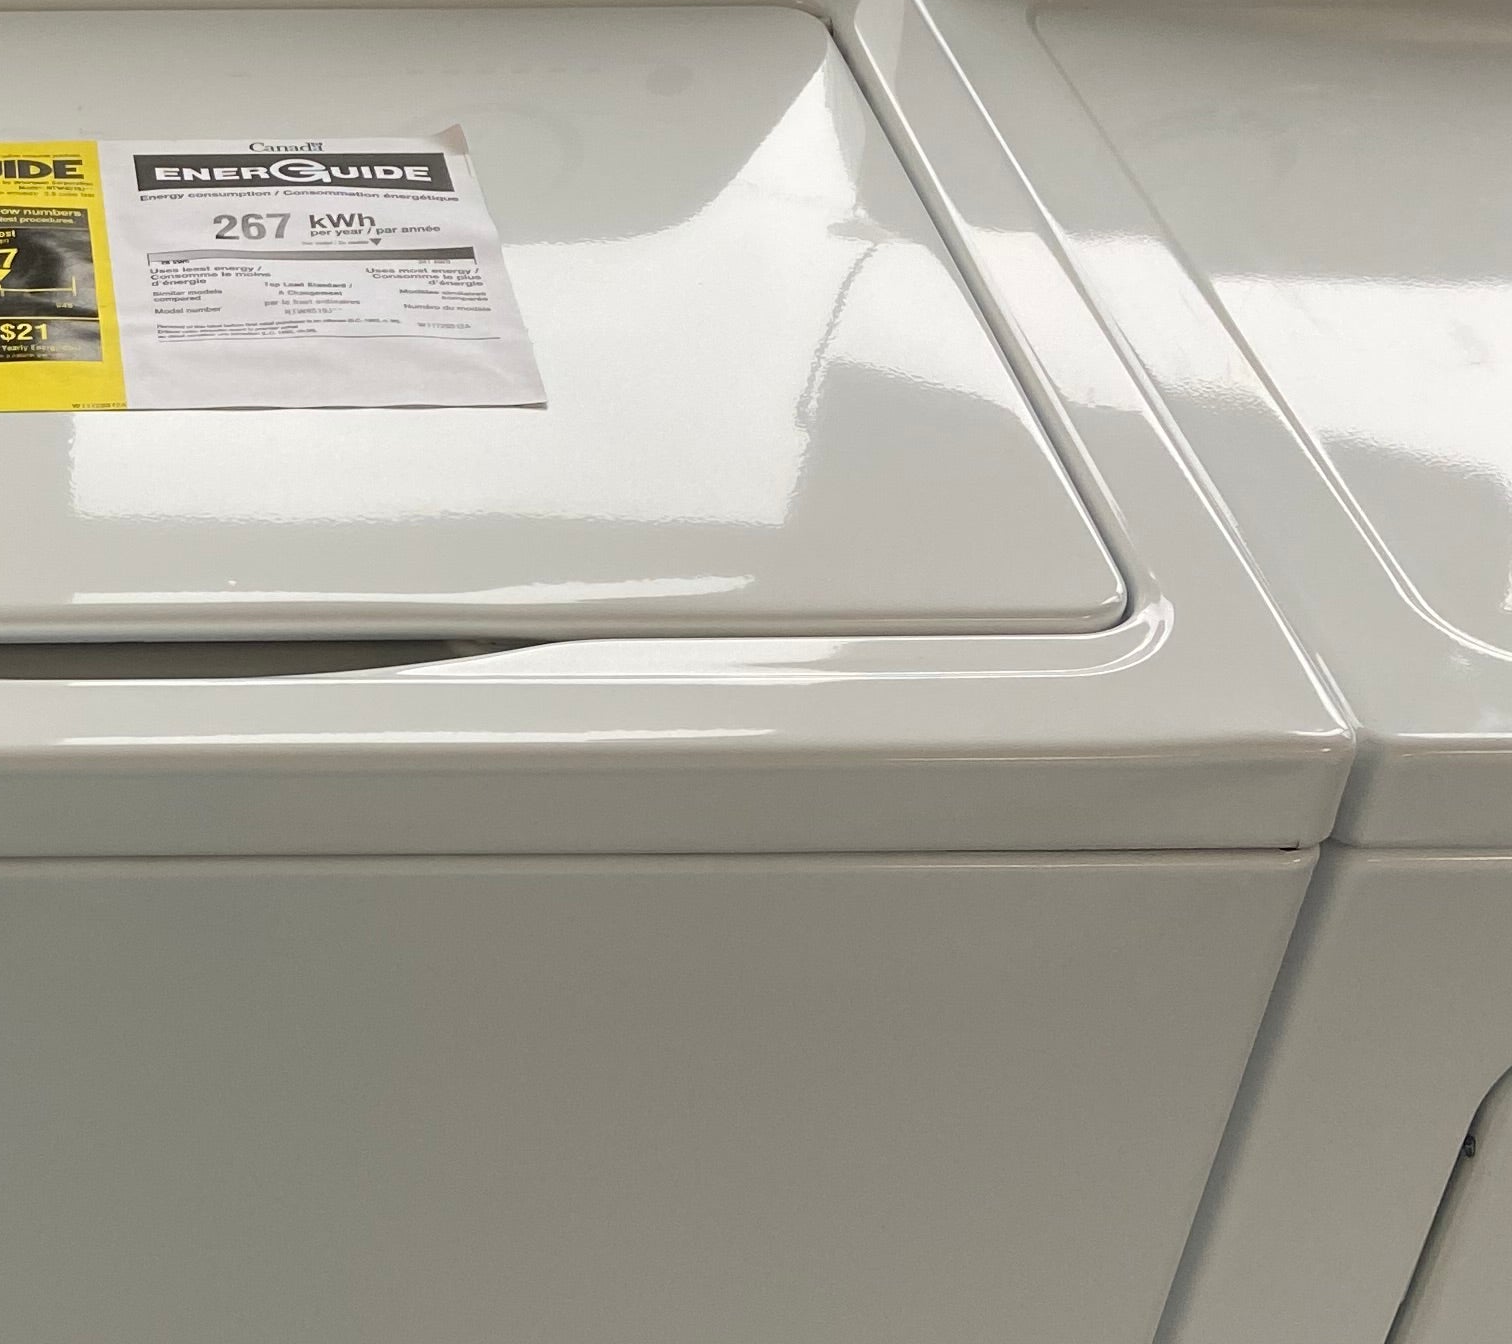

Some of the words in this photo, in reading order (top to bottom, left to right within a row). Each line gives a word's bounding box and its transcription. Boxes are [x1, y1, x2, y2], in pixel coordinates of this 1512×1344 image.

[155, 158, 432, 183] ENERGUIDE
[140, 192, 184, 201] Energy
[188, 190, 271, 198] consumption
[283, 190, 380, 198] Consommation
[23, 209, 82, 217] numbers
[213, 213, 291, 240] 267
[309, 213, 376, 229] kWh
[310, 229, 331, 237] per
[337, 228, 364, 236] year
[376, 227, 398, 236] par
[0, 323, 48, 342] $21
